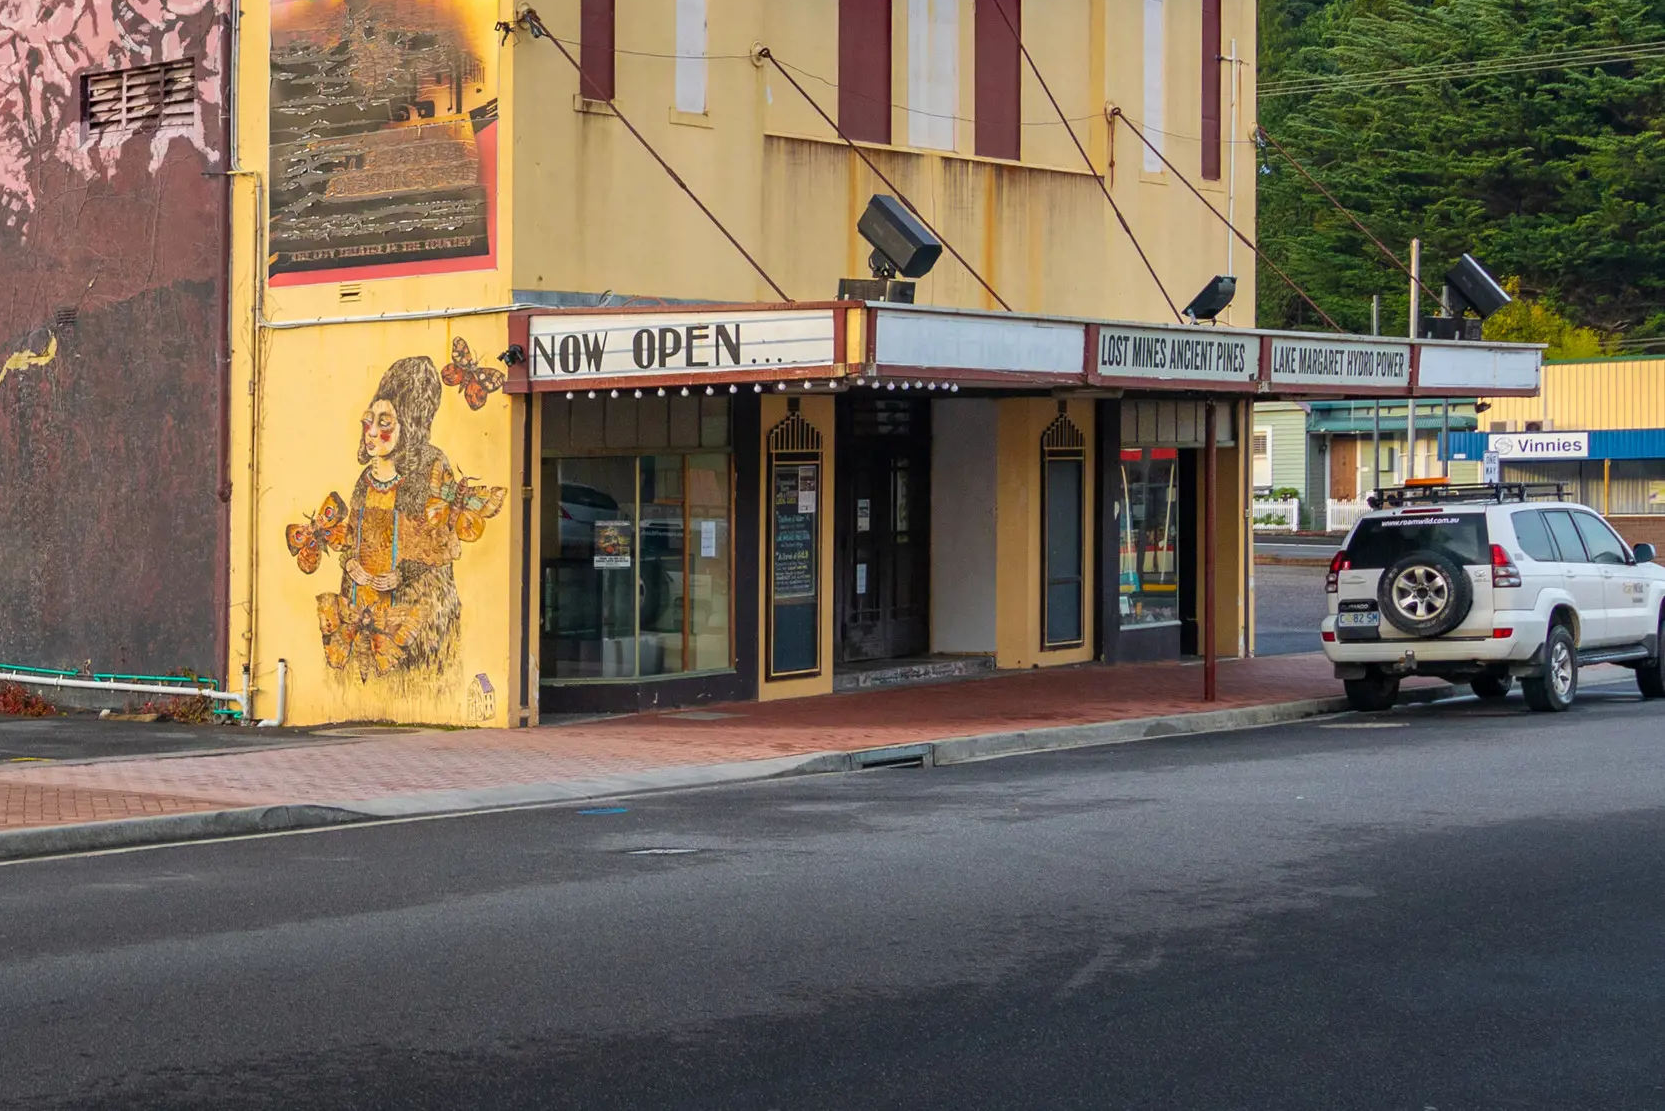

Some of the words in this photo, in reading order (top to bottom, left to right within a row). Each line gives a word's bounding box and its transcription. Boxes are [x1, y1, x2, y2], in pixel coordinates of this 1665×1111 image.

[533, 331, 608, 376] NOW
[1101, 333, 1130, 367] LOST
[1132, 336, 1167, 369] MINES
[1169, 338, 1214, 371] ANCIENT
[1216, 341, 1246, 373] PINES
[1273, 345, 1297, 373] LAKE
[1298, 347, 1345, 376] MARGARET
[1346, 349, 1374, 377] HYDRO
[1375, 351, 1405, 378] POWER
[1518, 438, 1582, 452] Vinnies
[1485, 455, 1497, 465] ONE
[1485, 467, 1497, 476] WAY
[1381, 517, 1460, 527] www.roamwild.com.au
